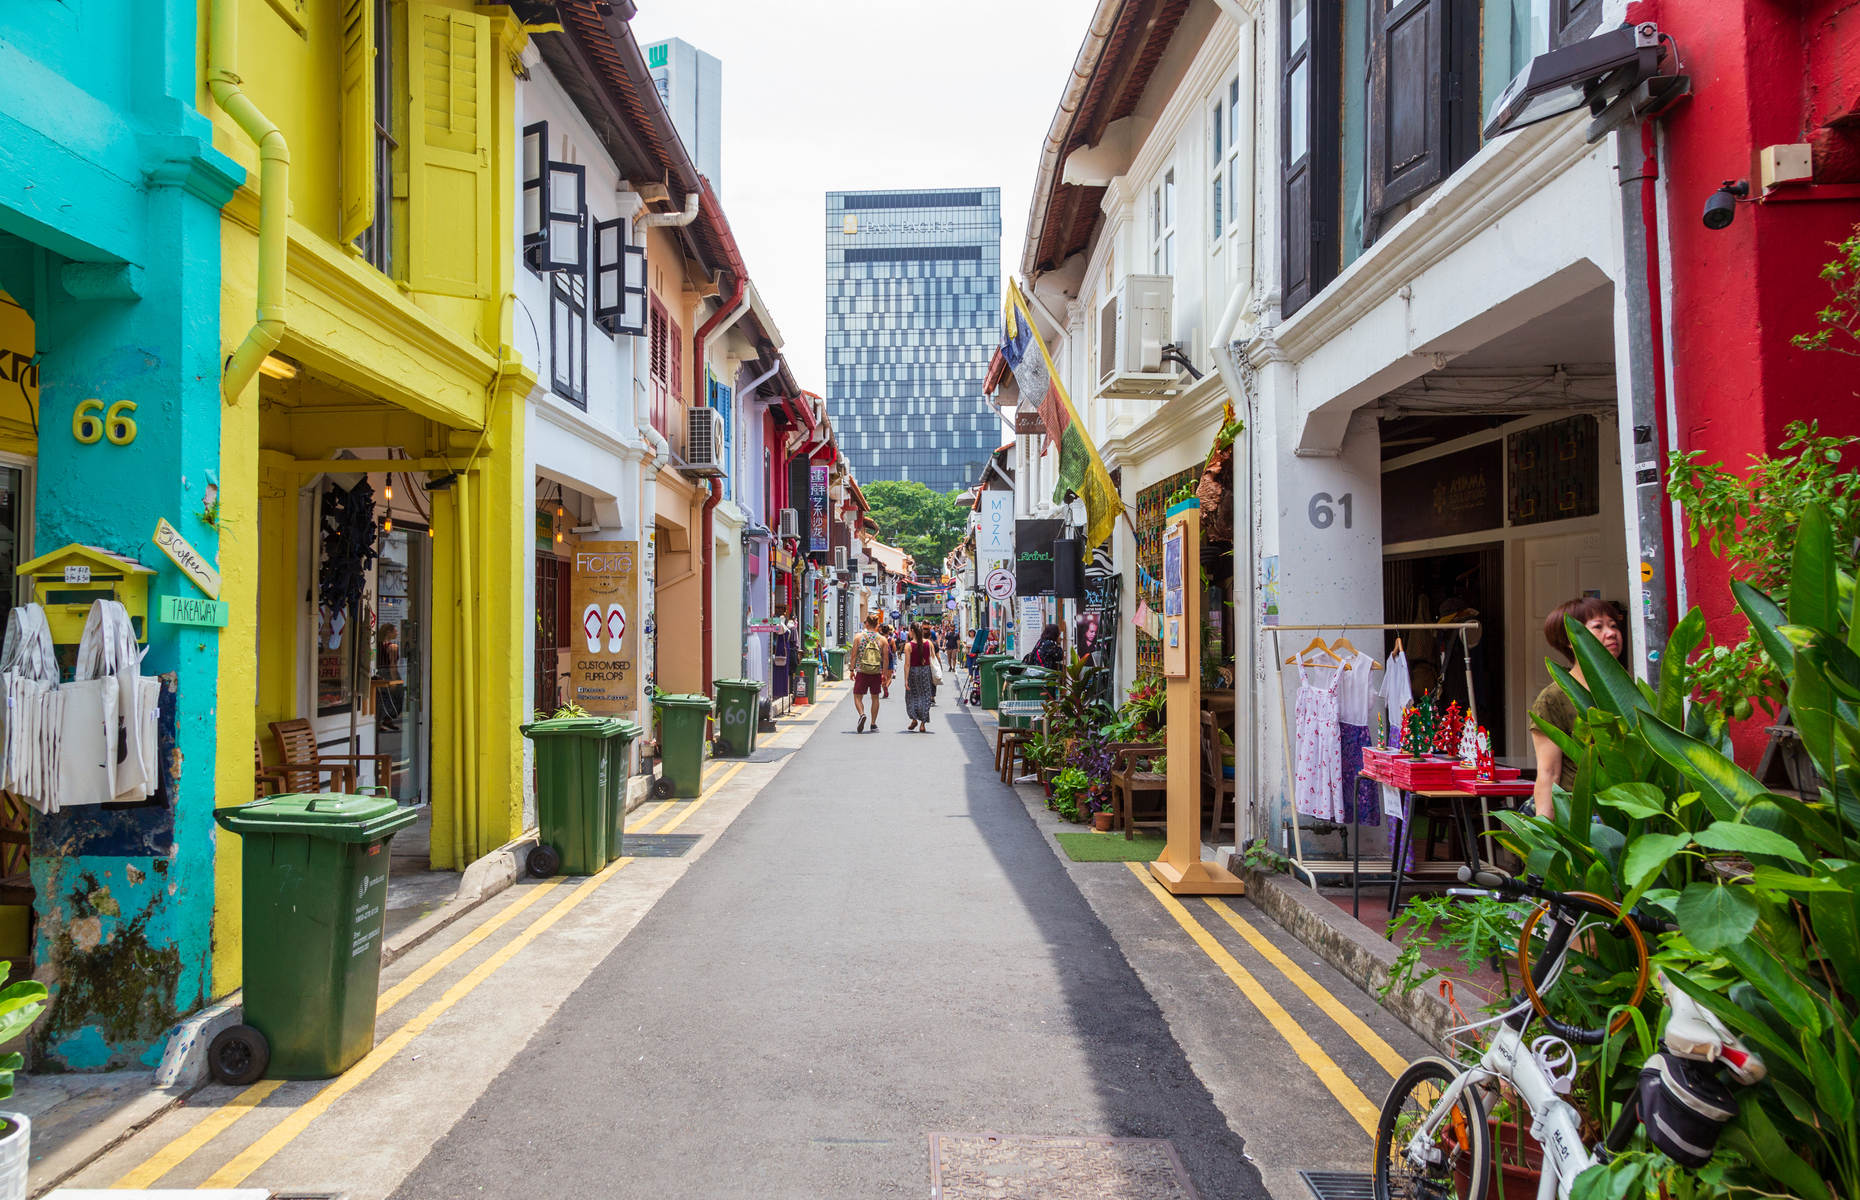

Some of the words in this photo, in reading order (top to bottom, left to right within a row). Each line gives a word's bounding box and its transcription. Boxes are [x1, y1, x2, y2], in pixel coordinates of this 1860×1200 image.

[865, 221, 894, 235] PAN
[900, 220, 955, 233] PACIFIC
[72, 398, 138, 446] 66
[1307, 491, 1353, 530] 61
[172, 538, 208, 579] Coffee
[172, 599, 217, 624] TAKEAWAY
[578, 660, 631, 670] CUSTOMISED
[724, 706, 748, 726] 60
[1553, 1129, 1570, 1160] HA-01
